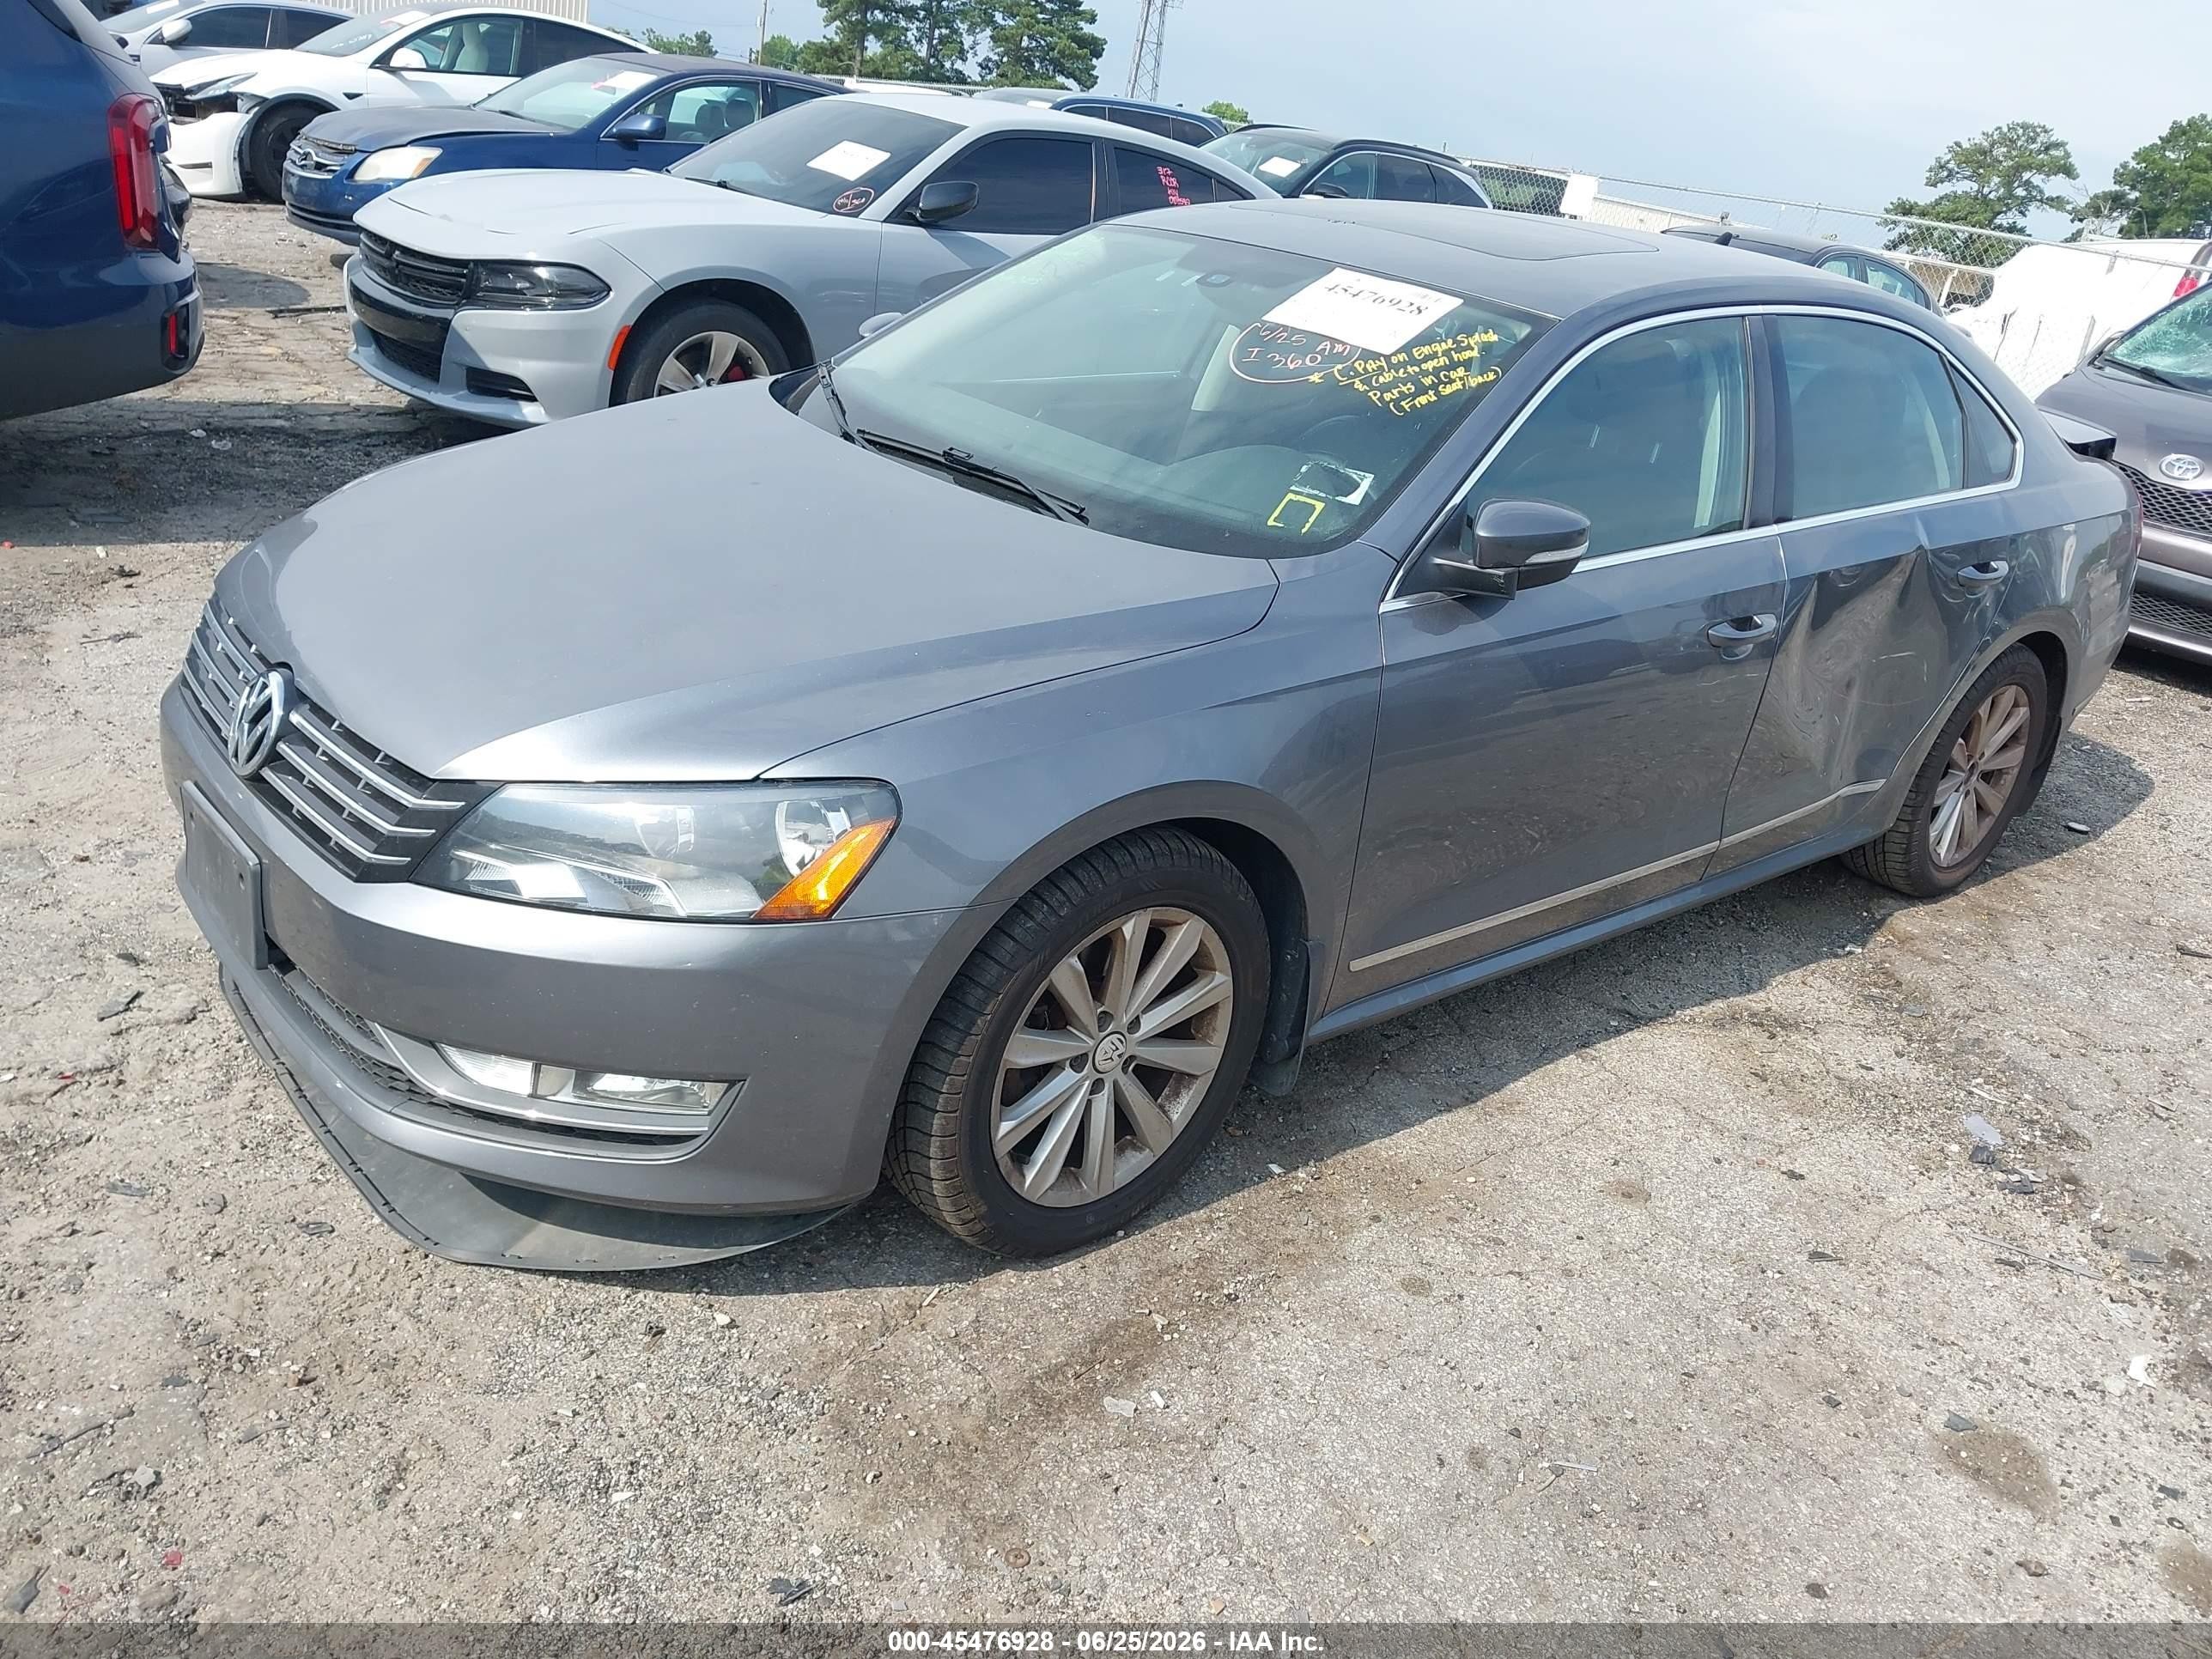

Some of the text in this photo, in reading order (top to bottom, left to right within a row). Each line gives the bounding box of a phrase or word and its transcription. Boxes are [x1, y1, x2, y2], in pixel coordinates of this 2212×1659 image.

[1323, 283, 1430, 317] 45476928
[1259, 323, 1307, 345] 6/25
[1267, 352, 1322, 369] 360
[1391, 352, 1409, 364] on
[1412, 337, 1457, 360] Engine
[1421, 356, 1450, 373] open
[1367, 382, 1416, 407] Parts
[1419, 375, 1438, 386] in
